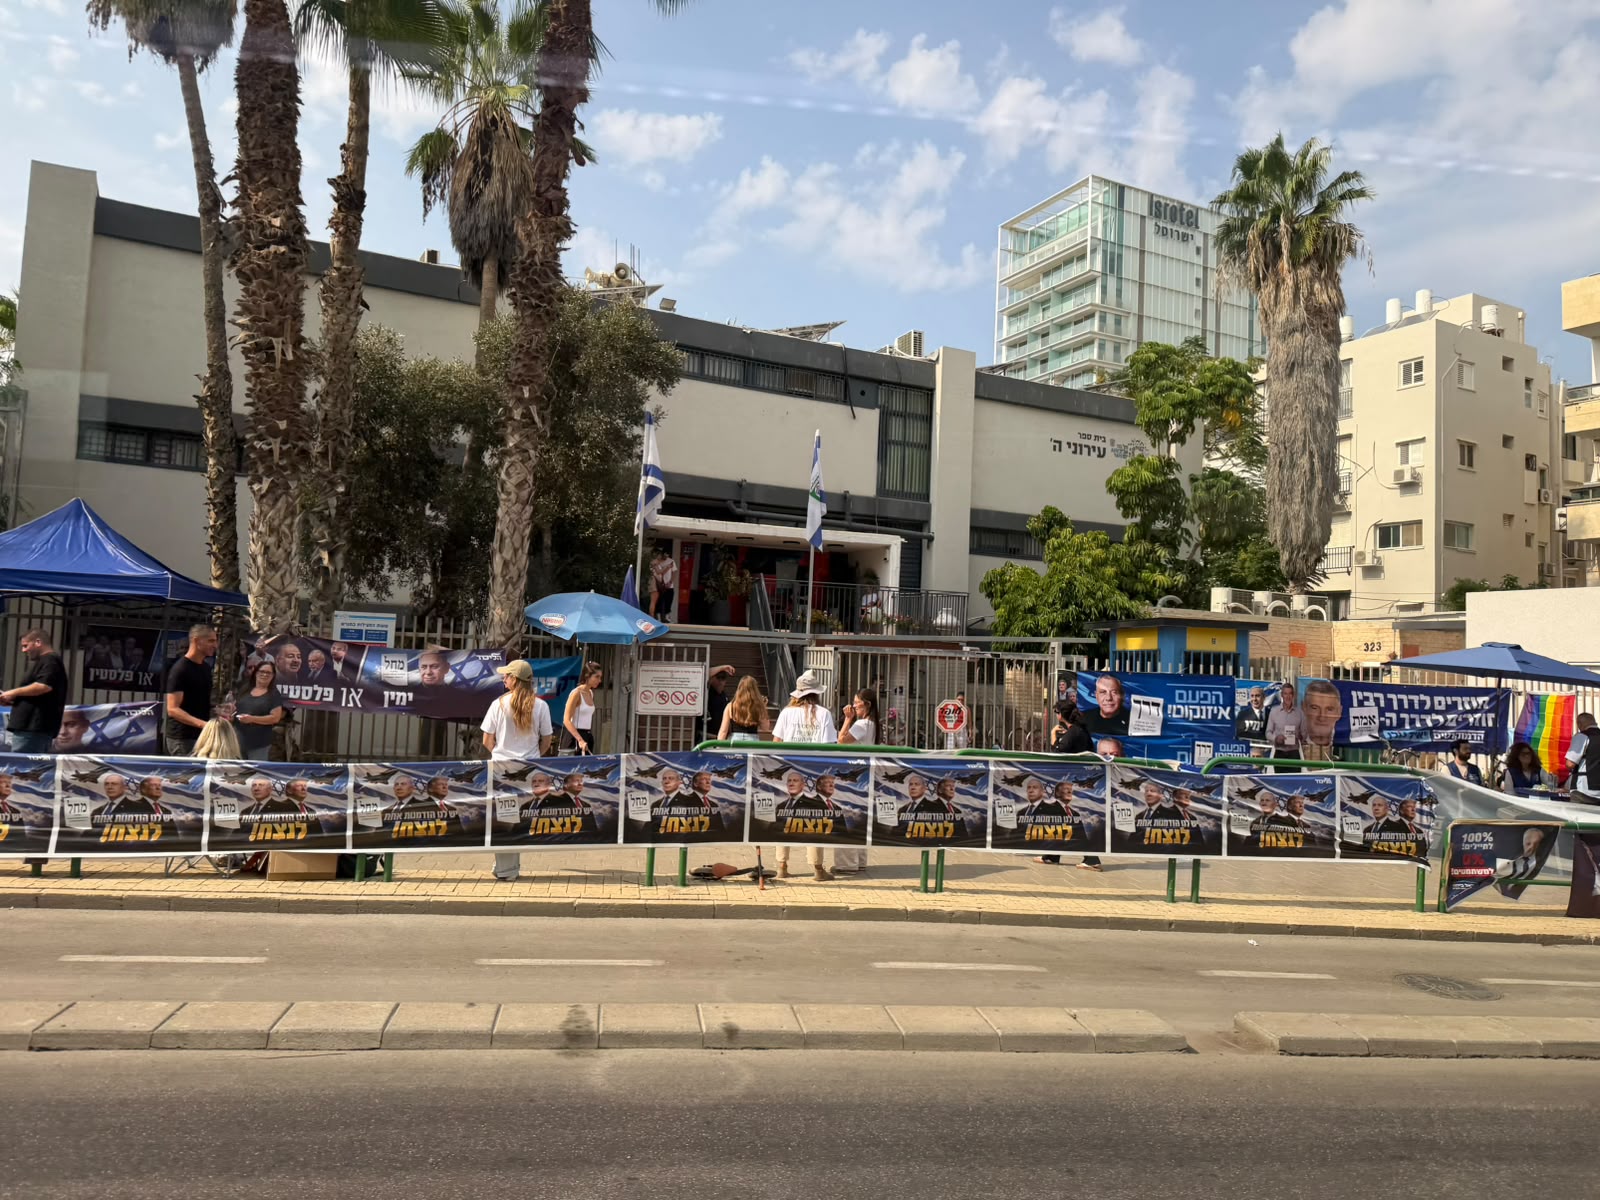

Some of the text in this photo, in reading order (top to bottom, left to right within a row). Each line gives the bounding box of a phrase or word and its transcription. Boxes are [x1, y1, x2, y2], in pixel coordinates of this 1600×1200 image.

[1078, 432, 1106, 442] בית ספר
[1050, 438, 1062, 452] ה'
[1066, 441, 1106, 458] עירוני
[1364, 642, 1382, 652] 323
[384, 656, 405, 670] מחל
[89, 667, 154, 686] או פלסטין
[340, 688, 364, 708] או
[384, 690, 414, 708] ימין
[1175, 689, 1223, 704] הפעם
[1351, 690, 1490, 710] חוזרים לדרך רבין
[1167, 704, 1231, 720] איזנקוט!
[1352, 714, 1376, 726] אמת
[1400, 713, 1444, 729] לדרך
[1220, 744, 1246, 752] הפעם
[66, 800, 86, 813] מחל
[216, 801, 236, 813] מחל
[360, 800, 378, 812] מחל
[499, 797, 516, 809] מחל
[630, 795, 647, 807] מחל
[756, 796, 772, 807] מחל
[879, 799, 895, 811] מחל
[521, 808, 539, 817] אחת
[652, 807, 669, 815] אחת
[777, 809, 794, 817] אחת
[998, 802, 1013, 813] מחל
[1116, 805, 1132, 817] מחל
[92, 814, 113, 823] אחת
[384, 812, 403, 821] אחת
[900, 812, 916, 820] אחת
[392, 819, 448, 838] לנצח!
[529, 816, 582, 835] לנצח!
[659, 815, 710, 834] לנצח!
[784, 816, 833, 834] לנצח!
[905, 821, 954, 838] לנצח!
[1345, 819, 1360, 831] מחל
[100, 823, 162, 843] לנצח!
[249, 821, 308, 842] לנצח!
[1025, 823, 1072, 841] לנצח!
[1144, 827, 1190, 845] לנצח!
[1462, 832, 1493, 843] 100%
[1259, 831, 1304, 848] לנצח!
[1462, 854, 1485, 865] 0%
